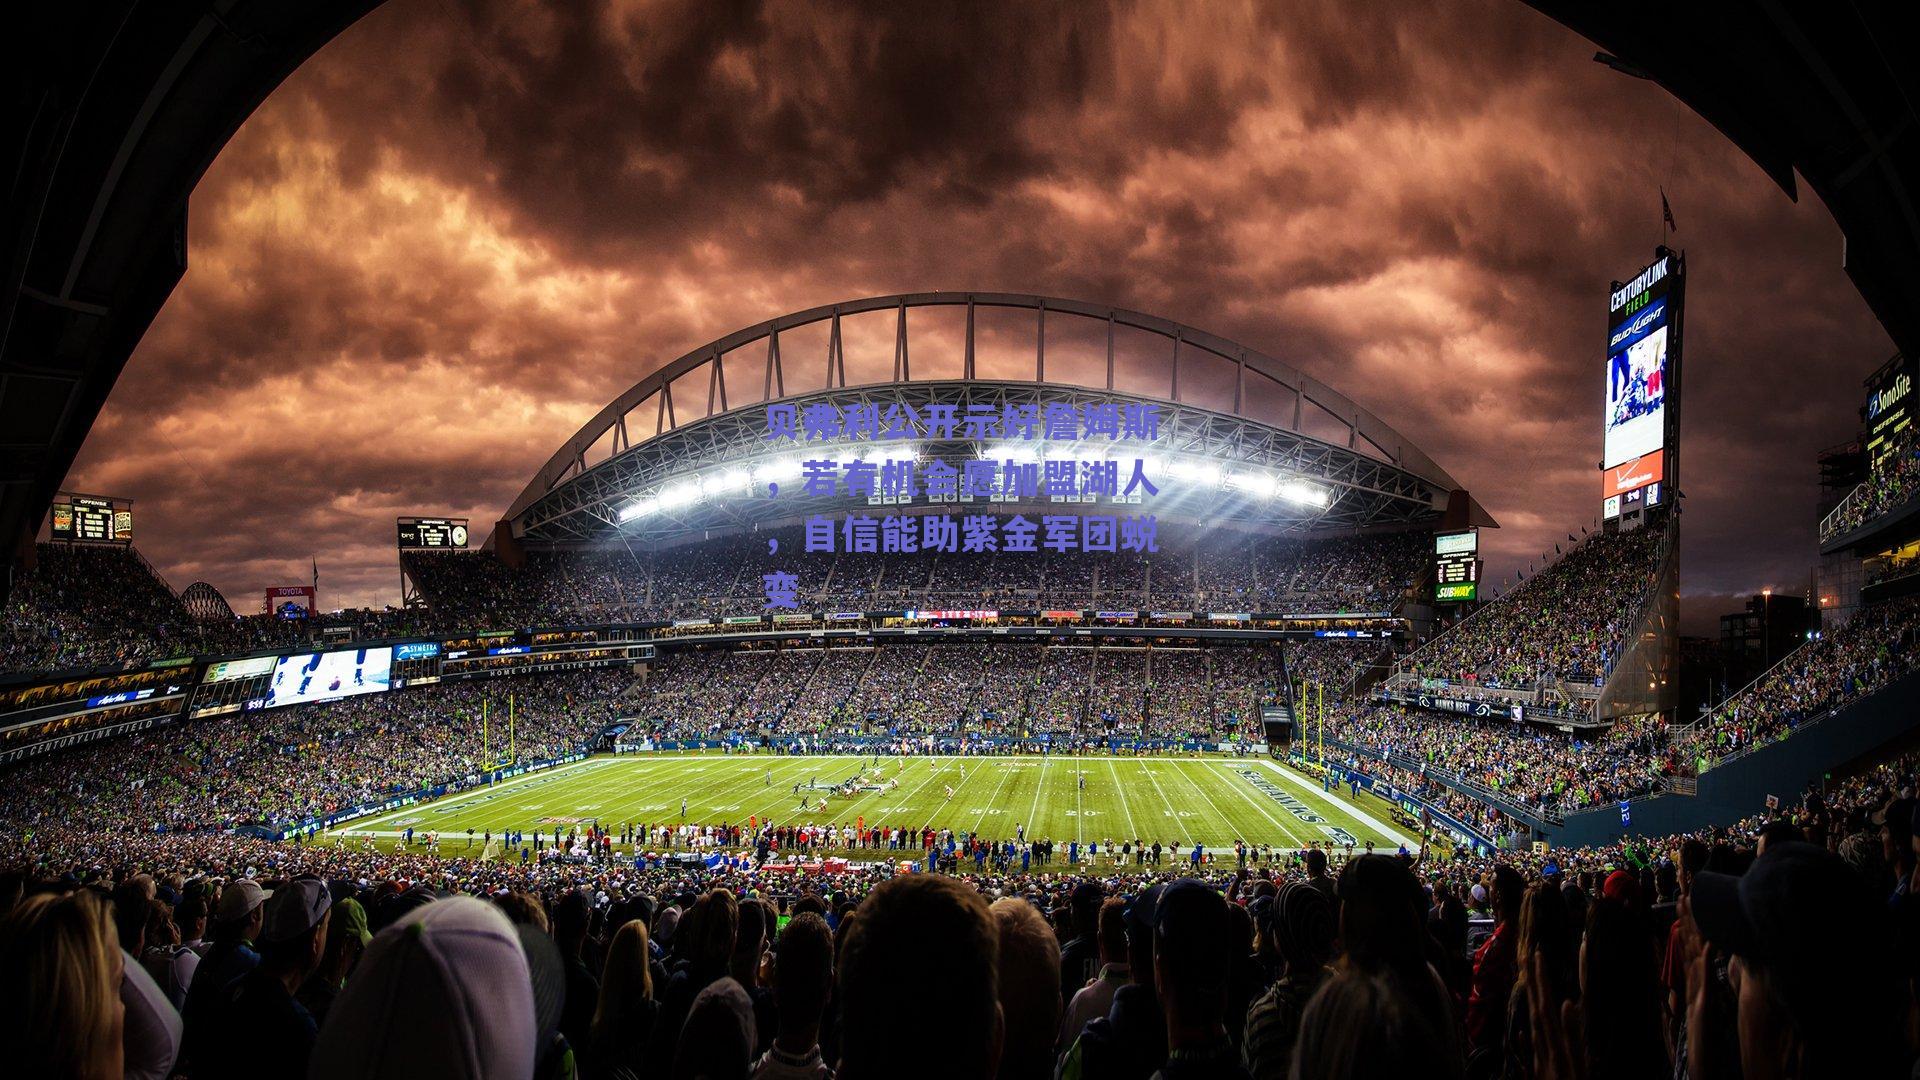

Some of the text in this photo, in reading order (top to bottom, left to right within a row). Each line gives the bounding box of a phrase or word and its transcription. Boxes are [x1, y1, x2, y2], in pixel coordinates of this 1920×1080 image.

[1610, 256, 1668, 312] CENTURYLINK
[1625, 290, 1649, 316] FIELD
[1610, 305, 1664, 346] BUD LIGHT
[1877, 373, 1911, 414] SonoSite
[80, 499, 107, 507] OFFENSE
[278, 587, 303, 596] TOYOTA
[1437, 585, 1474, 599] SUBWAY
[410, 644, 437, 652] SYMETRA
[490, 668, 516, 677] HOME
[1434, 698, 1470, 712] HAWKS NEST
[10, 749, 24, 762] TO
[30, 729, 112, 756] CENTURYLINK
[118, 719, 153, 735] FIELD
[1620, 805, 1630, 822] 12
